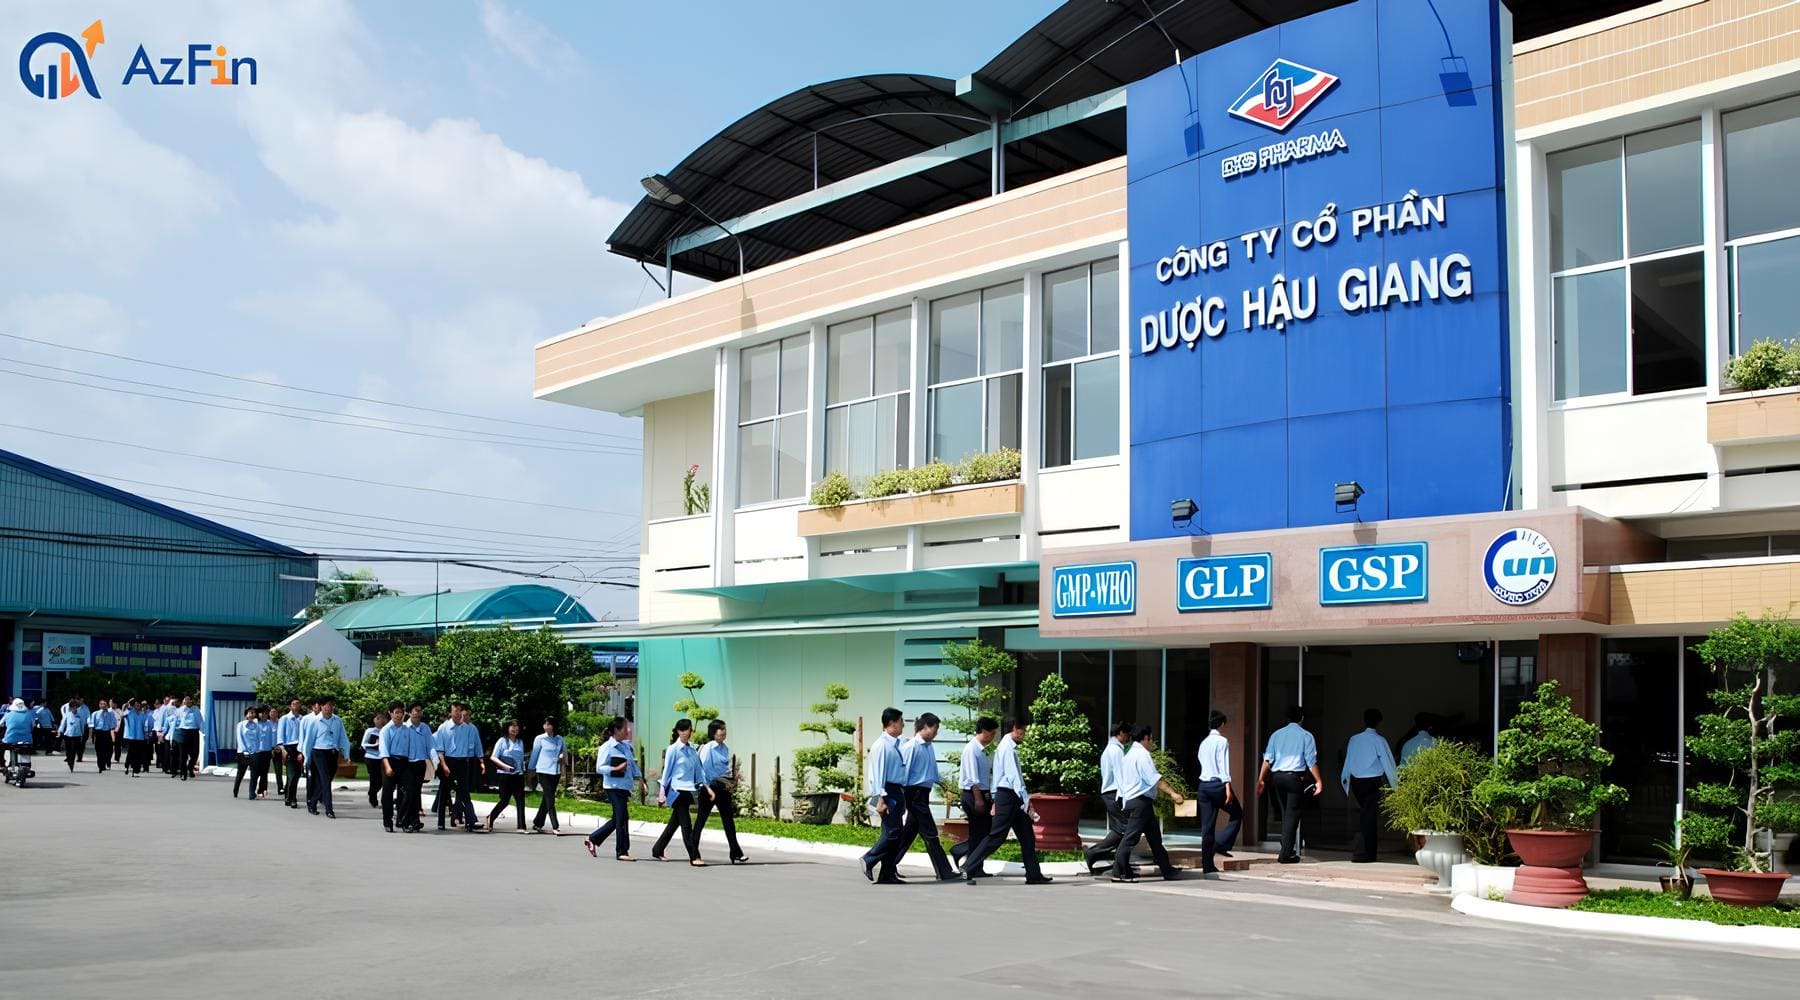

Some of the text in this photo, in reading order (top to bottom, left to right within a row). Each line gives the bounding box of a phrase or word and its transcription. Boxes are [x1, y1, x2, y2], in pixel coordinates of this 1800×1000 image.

[1259, 129, 1348, 169] PHARMA
[1156, 188, 1446, 284] CÔNG TY CỔ PHẦN
[1140, 252, 1473, 354] DƯỢC HẬU GIANG
[1056, 570, 1132, 609] GMP-WHO
[1185, 564, 1266, 600] GLP
[1328, 554, 1419, 593] GSP
